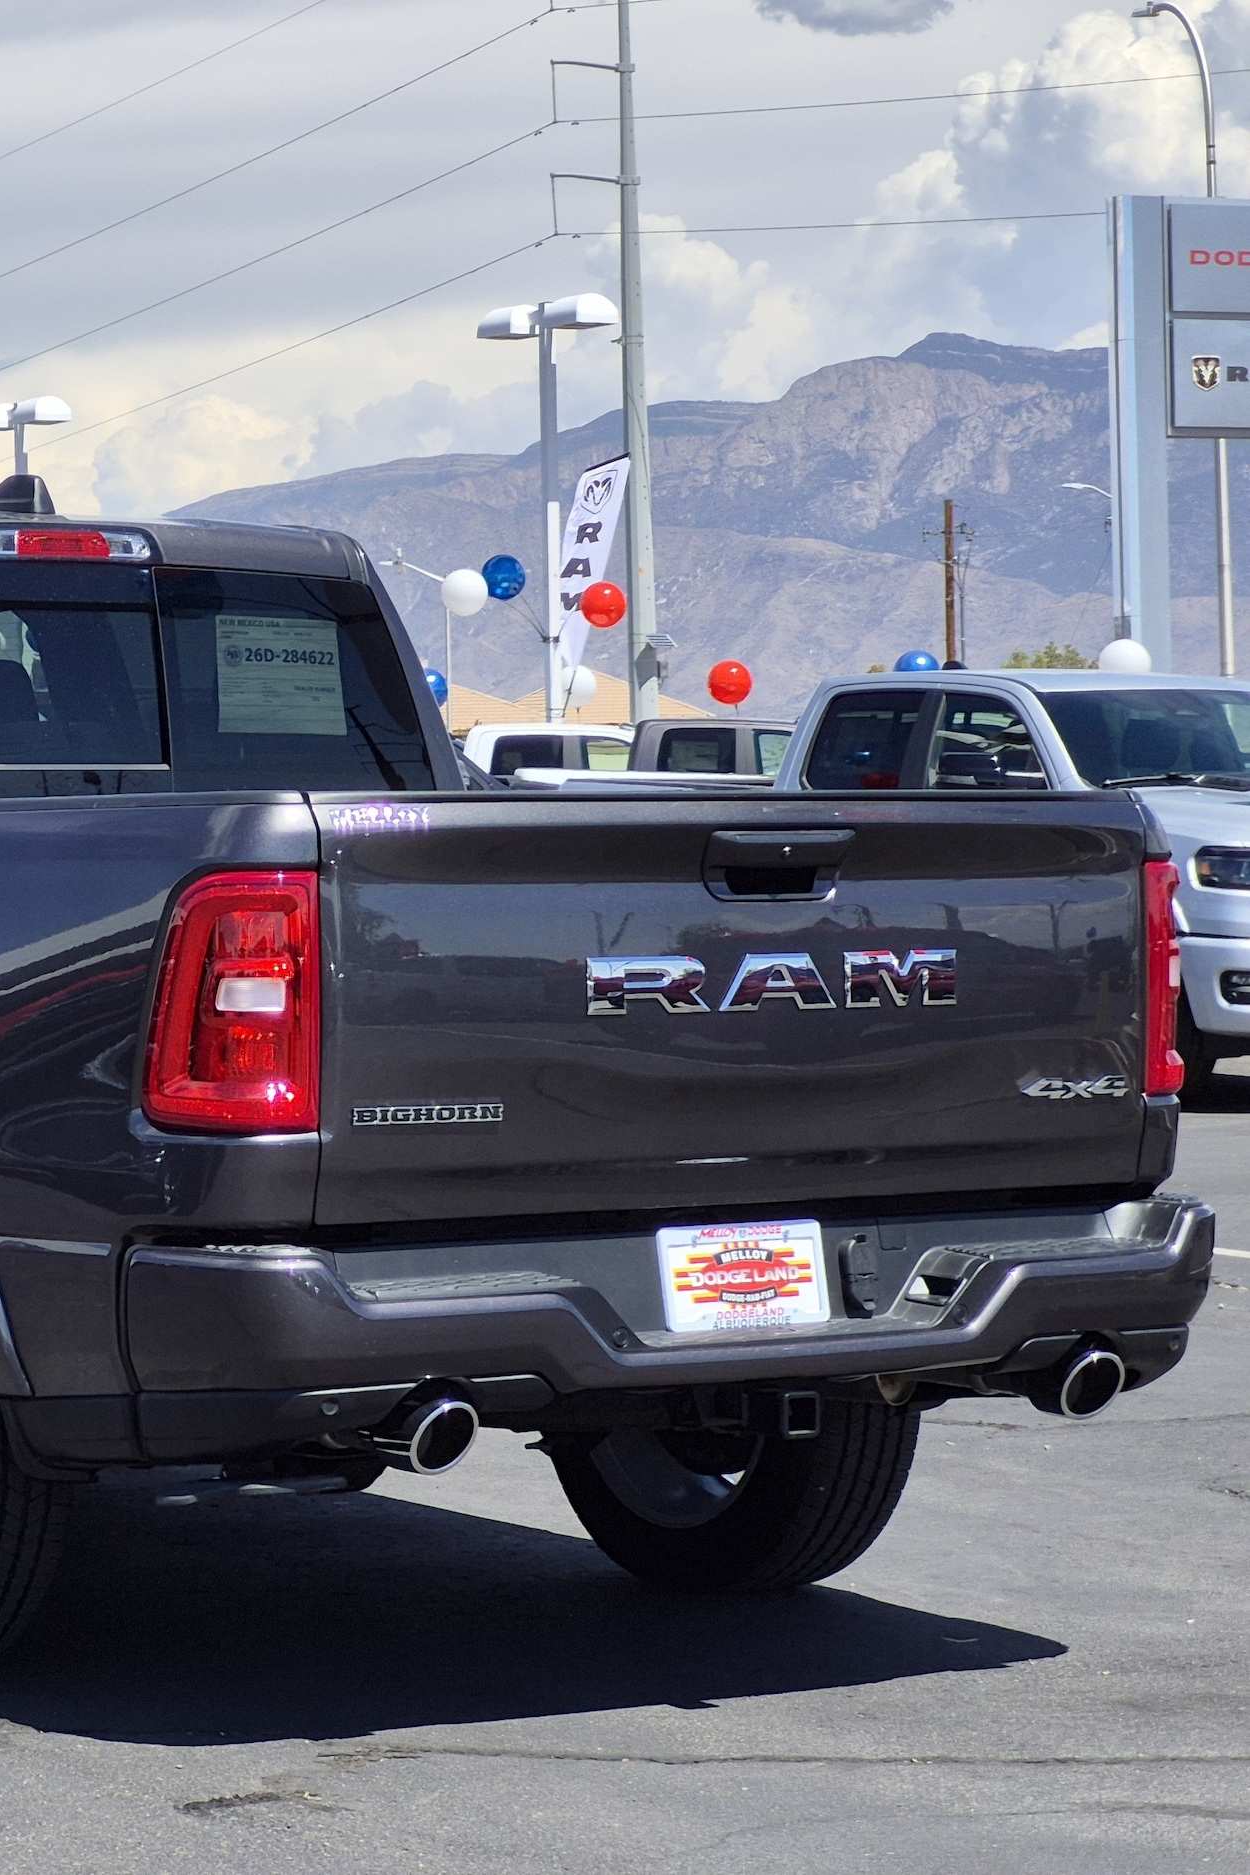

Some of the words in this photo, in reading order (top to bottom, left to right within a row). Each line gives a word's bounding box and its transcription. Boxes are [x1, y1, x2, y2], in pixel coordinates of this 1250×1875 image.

[218, 618, 236, 627] NEW
[237, 619, 265, 628] MEXICO
[266, 620, 281, 628] USA
[244, 647, 335, 666] 26D-284622
[586, 949, 957, 1015] RAM
[352, 1103, 504, 1126] BIGHORN
[698, 1227, 737, 1239] MELLOY
[747, 1225, 783, 1236] DODGE
[720, 1249, 768, 1263] MELLOY
[716, 1307, 785, 1320] DODGELAND
[712, 1315, 791, 1330] ALBUQUERQUE
